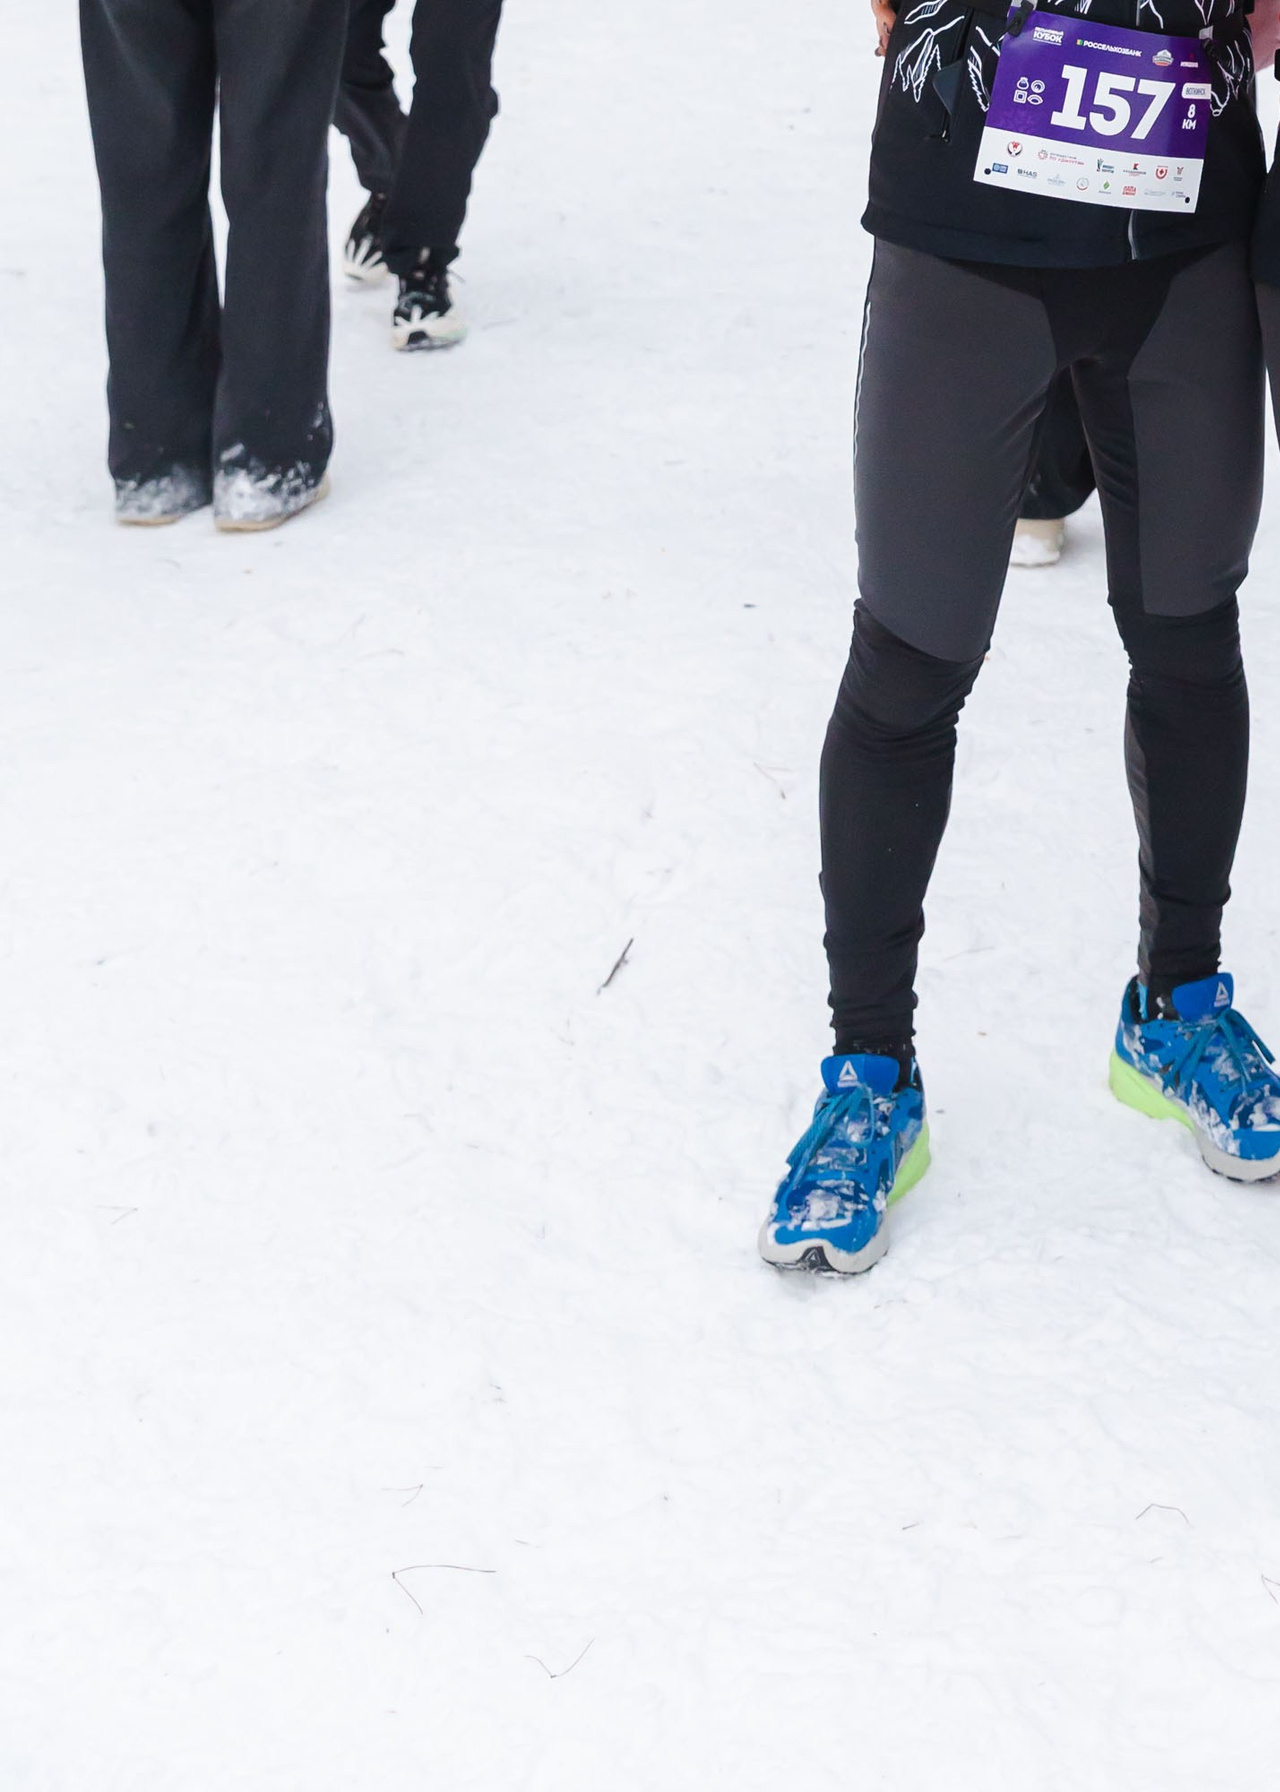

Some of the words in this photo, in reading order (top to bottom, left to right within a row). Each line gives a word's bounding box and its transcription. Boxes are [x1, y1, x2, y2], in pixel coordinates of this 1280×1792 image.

[1033, 30, 1062, 44] КУБОК
[1083, 40, 1142, 57] РОССЕЛЬХОЗБАНК
[1050, 64, 1176, 140] 157
[1187, 103, 1196, 119] 8
[1182, 118, 1197, 129] КМ
